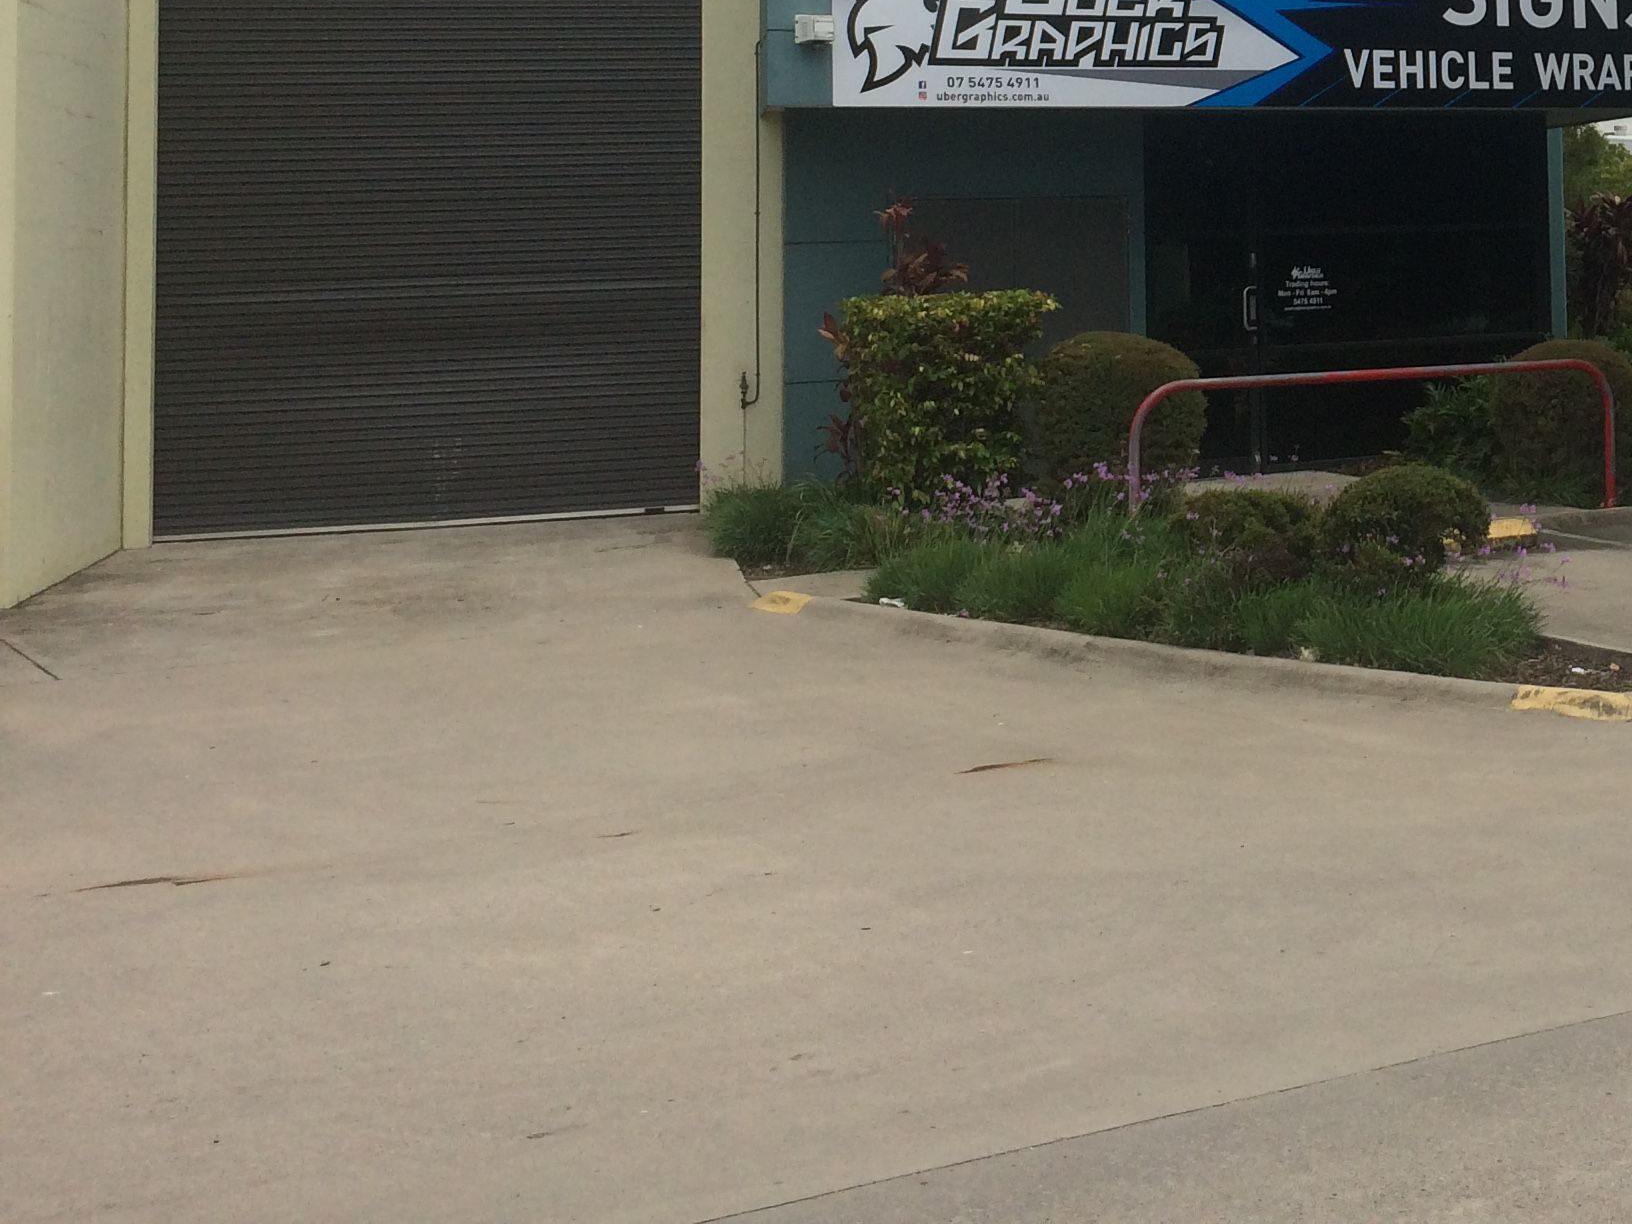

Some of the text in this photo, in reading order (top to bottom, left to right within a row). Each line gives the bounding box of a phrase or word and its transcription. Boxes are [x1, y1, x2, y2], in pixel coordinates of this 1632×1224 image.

[1343, 47, 1514, 90] VEHICLE
[947, 76, 1040, 89] 07 5475 4911
[936, 90, 1050, 104] ubergraphics.com.au
